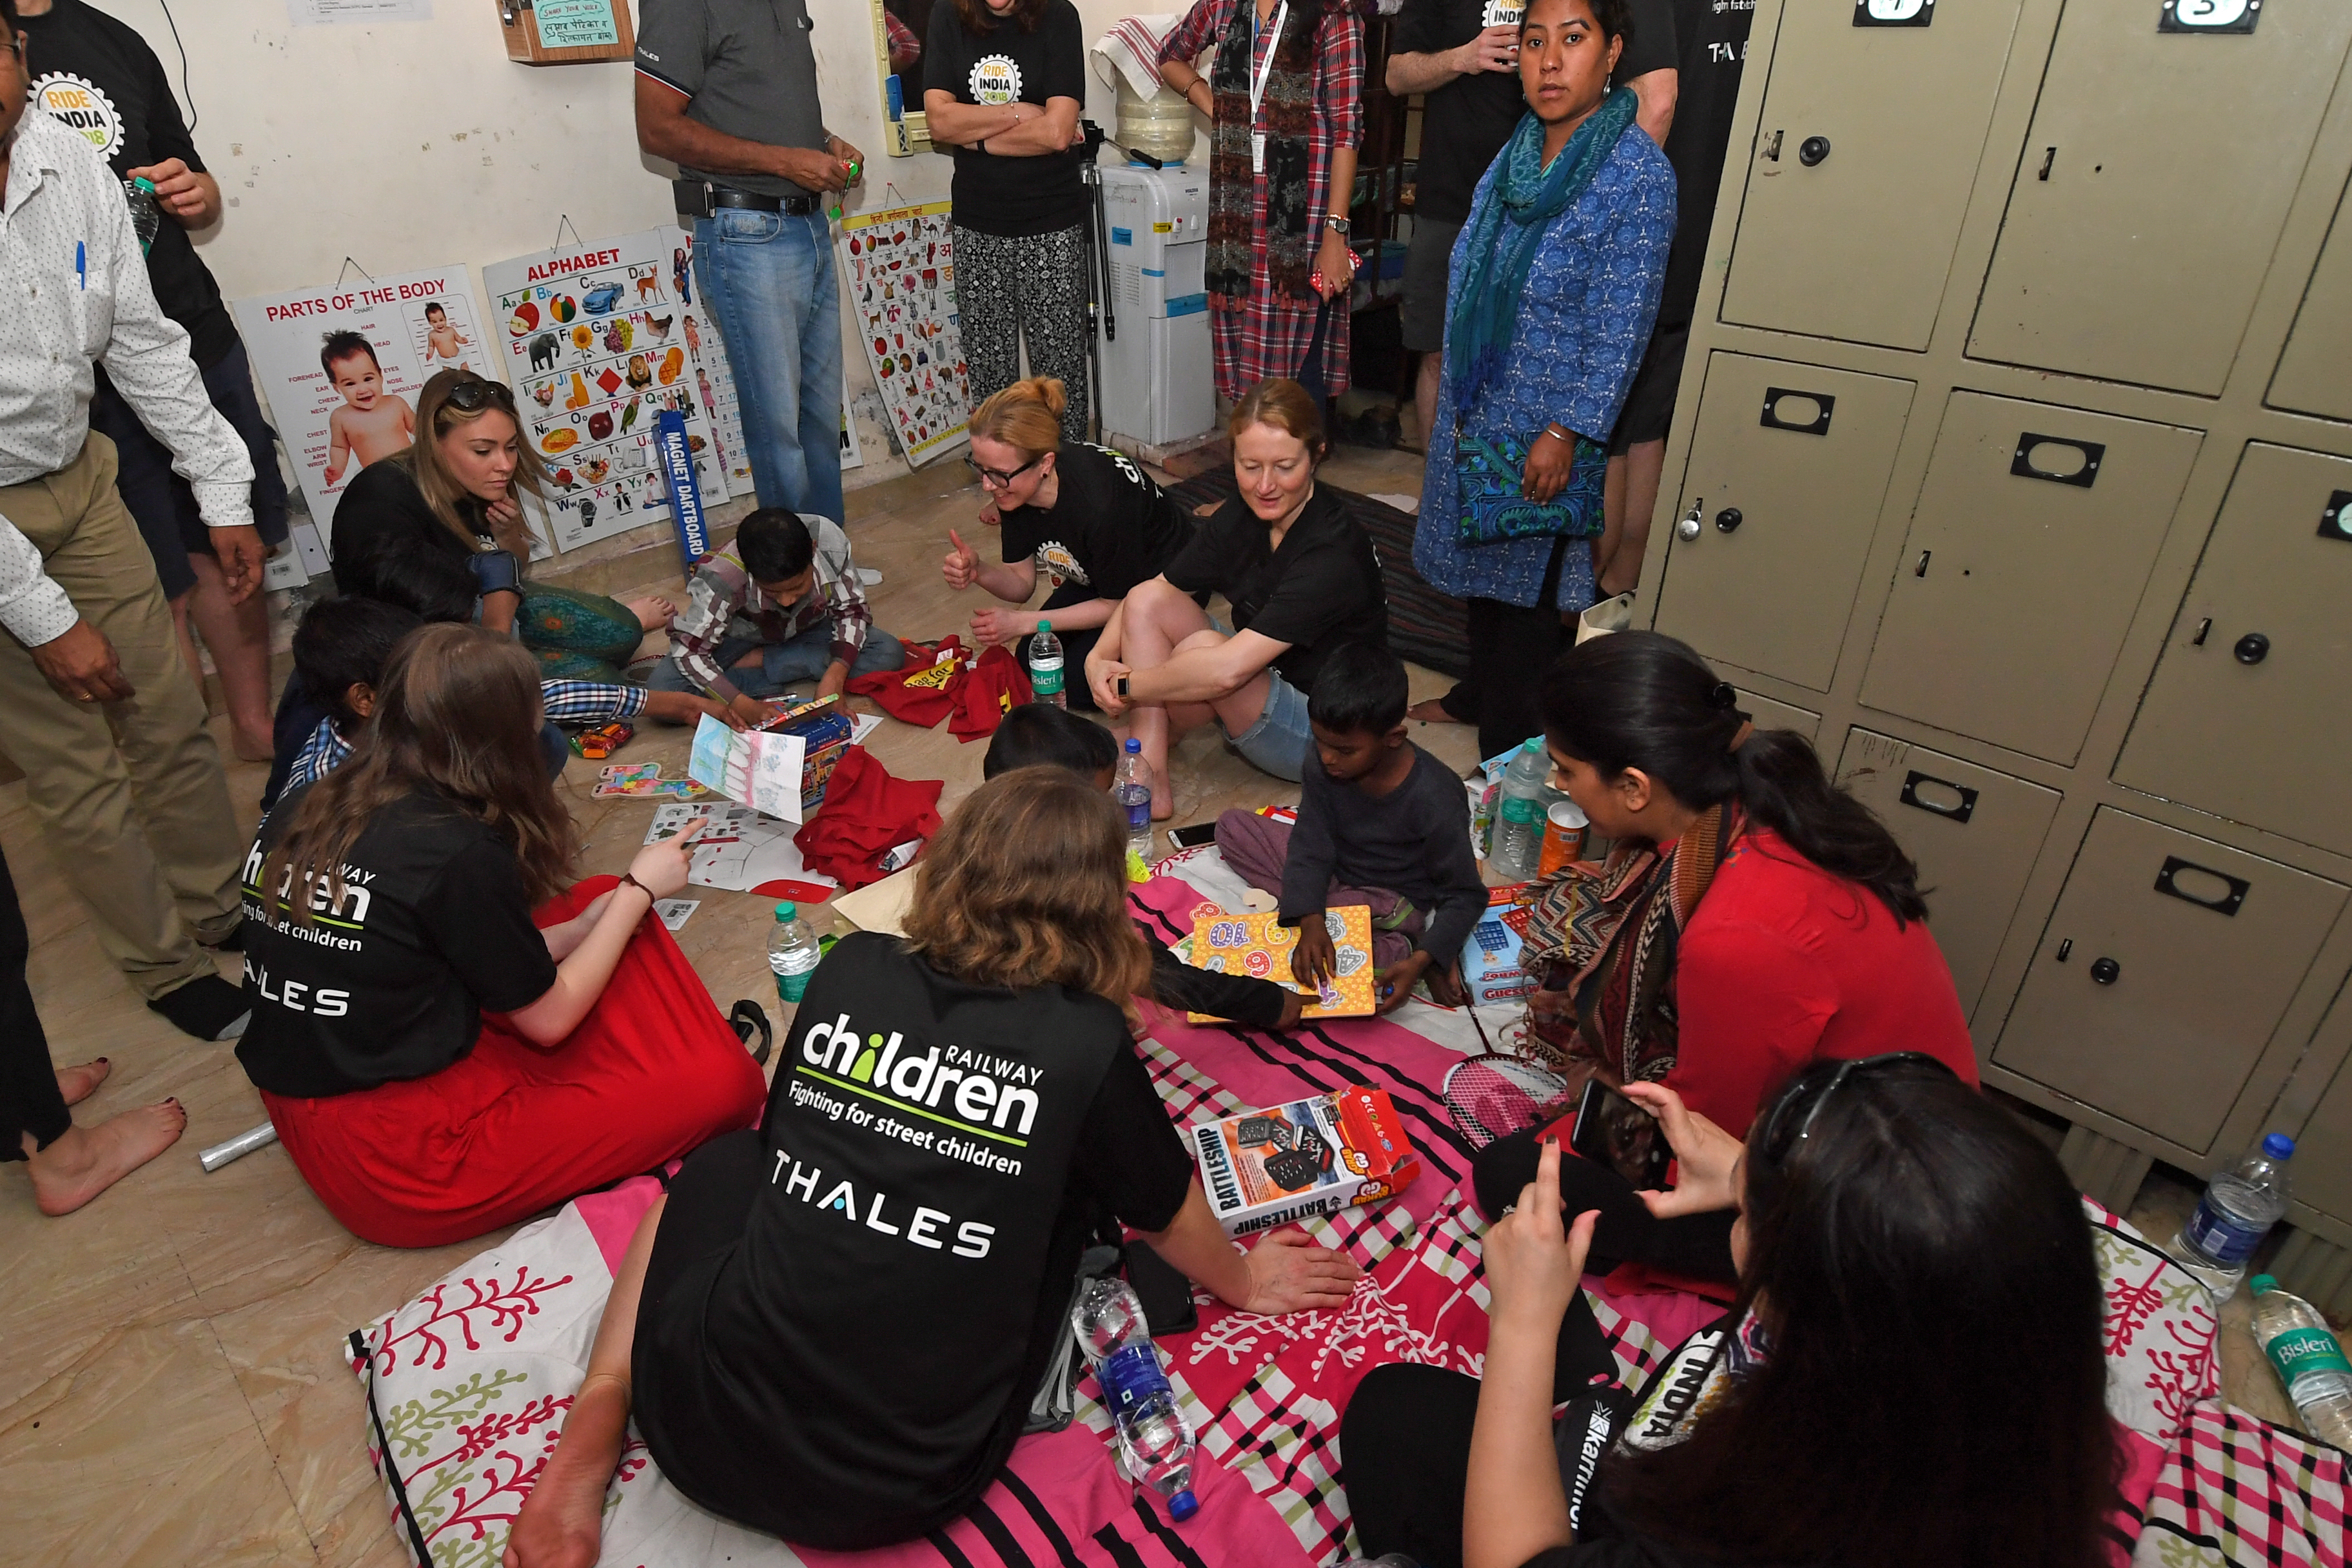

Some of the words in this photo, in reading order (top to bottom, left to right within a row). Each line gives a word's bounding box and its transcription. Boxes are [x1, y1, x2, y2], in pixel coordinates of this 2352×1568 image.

[979, 77, 1010, 91] INDIA
[983, 65, 1008, 77] RIDE
[46, 91, 92, 108] RIDE
[984, 92, 1008, 101] 2018
[870, 212, 884, 224] हिन्दी
[887, 210, 908, 220] वर्णमाला
[912, 206, 923, 216] चार्ट
[527, 248, 620, 282] ALPHABET
[266, 299, 328, 322] PARTS
[332, 294, 355, 311] OF
[359, 288, 397, 306] THE
[399, 278, 445, 300] BODY
[502, 297, 517, 310] Aa
[536, 286, 553, 300] Bb
[580, 277, 596, 289] Cc
[627, 267, 645, 280] Dd
[559, 329, 571, 342] Ff
[591, 321, 609, 334] Gg
[629, 312, 645, 326] Hh
[288, 372, 324, 383] FOREHEAD
[558, 373, 568, 386] Jj
[583, 366, 601, 379] Kk
[645, 351, 665, 364] Mm
[318, 397, 338, 405] CHEEK
[391, 384, 424, 395] SHOULDER
[534, 424, 550, 436] Nn
[571, 412, 588, 424] Oo
[611, 401, 625, 413] Pp
[645, 392, 663, 404] Qq
[306, 430, 328, 438] CHEST
[304, 445, 328, 455] ELBOW
[307, 460, 328, 469] WRIST
[573, 454, 587, 466] Ss
[605, 444, 620, 455] Tt
[637, 435, 653, 447] Uu
[666, 431, 690, 482] MAGNET
[556, 498, 577, 513] Ww
[594, 487, 610, 500] Xx
[627, 476, 642, 489] Yy
[677, 485, 705, 556] DARTBOARD
[1048, 550, 1071, 567] RIDE
[292, 923, 362, 952] children
[803, 1013, 1039, 1135] children
[945, 1044, 1044, 1086] RAILWAY
[789, 1079, 845, 1121] Fighting
[845, 1102, 875, 1134] for
[874, 1116, 935, 1150] street
[936, 1136, 1023, 1177] children
[1197, 1128, 1242, 1211] BATTLESHIP
[772, 1149, 995, 1259] THALES
[1233, 1197, 1328, 1235] BATTLESHIP
[2277, 1337, 2334, 1366] Bisleri
[1641, 1358, 1711, 1438] INDIA
